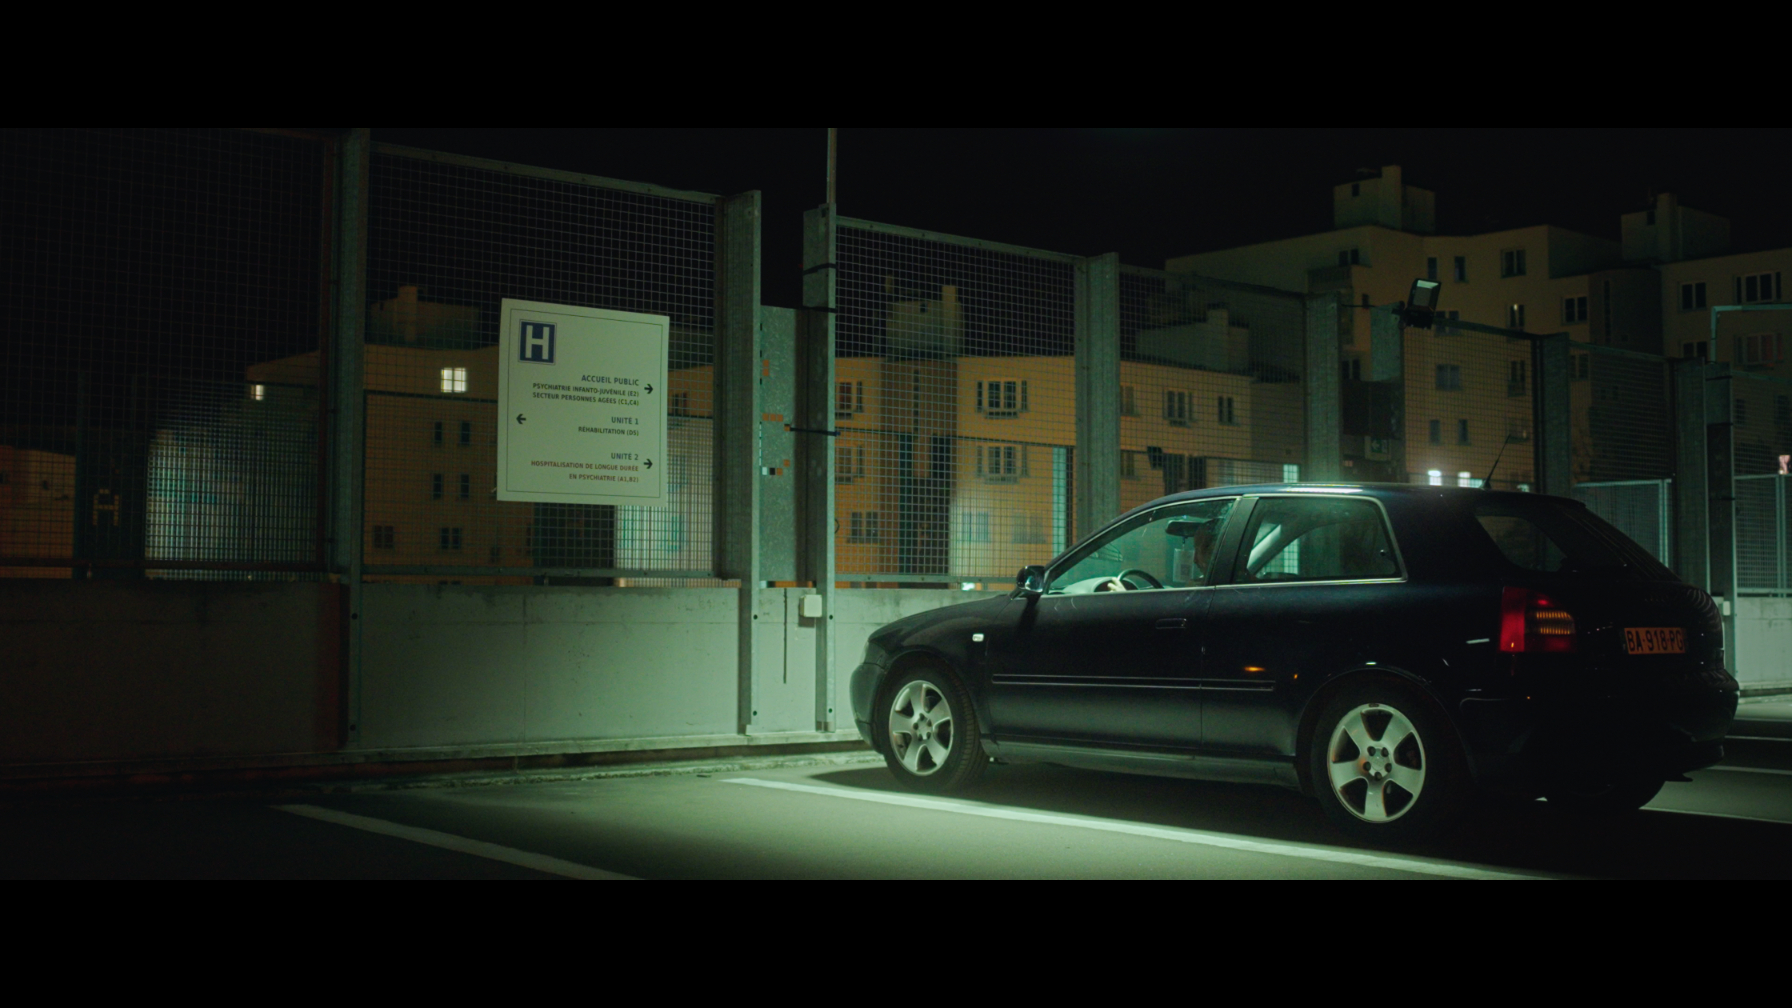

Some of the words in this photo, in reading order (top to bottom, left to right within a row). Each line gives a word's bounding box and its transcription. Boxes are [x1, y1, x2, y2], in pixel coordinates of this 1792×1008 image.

[525, 325, 550, 360] H
[581, 374, 612, 384] ACCUEIL
[614, 377, 640, 386] PUBLIC
[532, 383, 571, 392] PSYCHIATRIE
[572, 385, 626, 396] INFANTO-JUVÉNILE
[627, 389, 639, 397] (E2)
[532, 392, 560, 400] SECTEUR
[561, 393, 597, 403] PERSONNES
[634, 453, 639, 461] 2
[531, 460, 584, 469] HOSPITALISATION
[594, 463, 618, 471] LONGUE
[578, 474, 616, 482] PSYCHIATRIE
